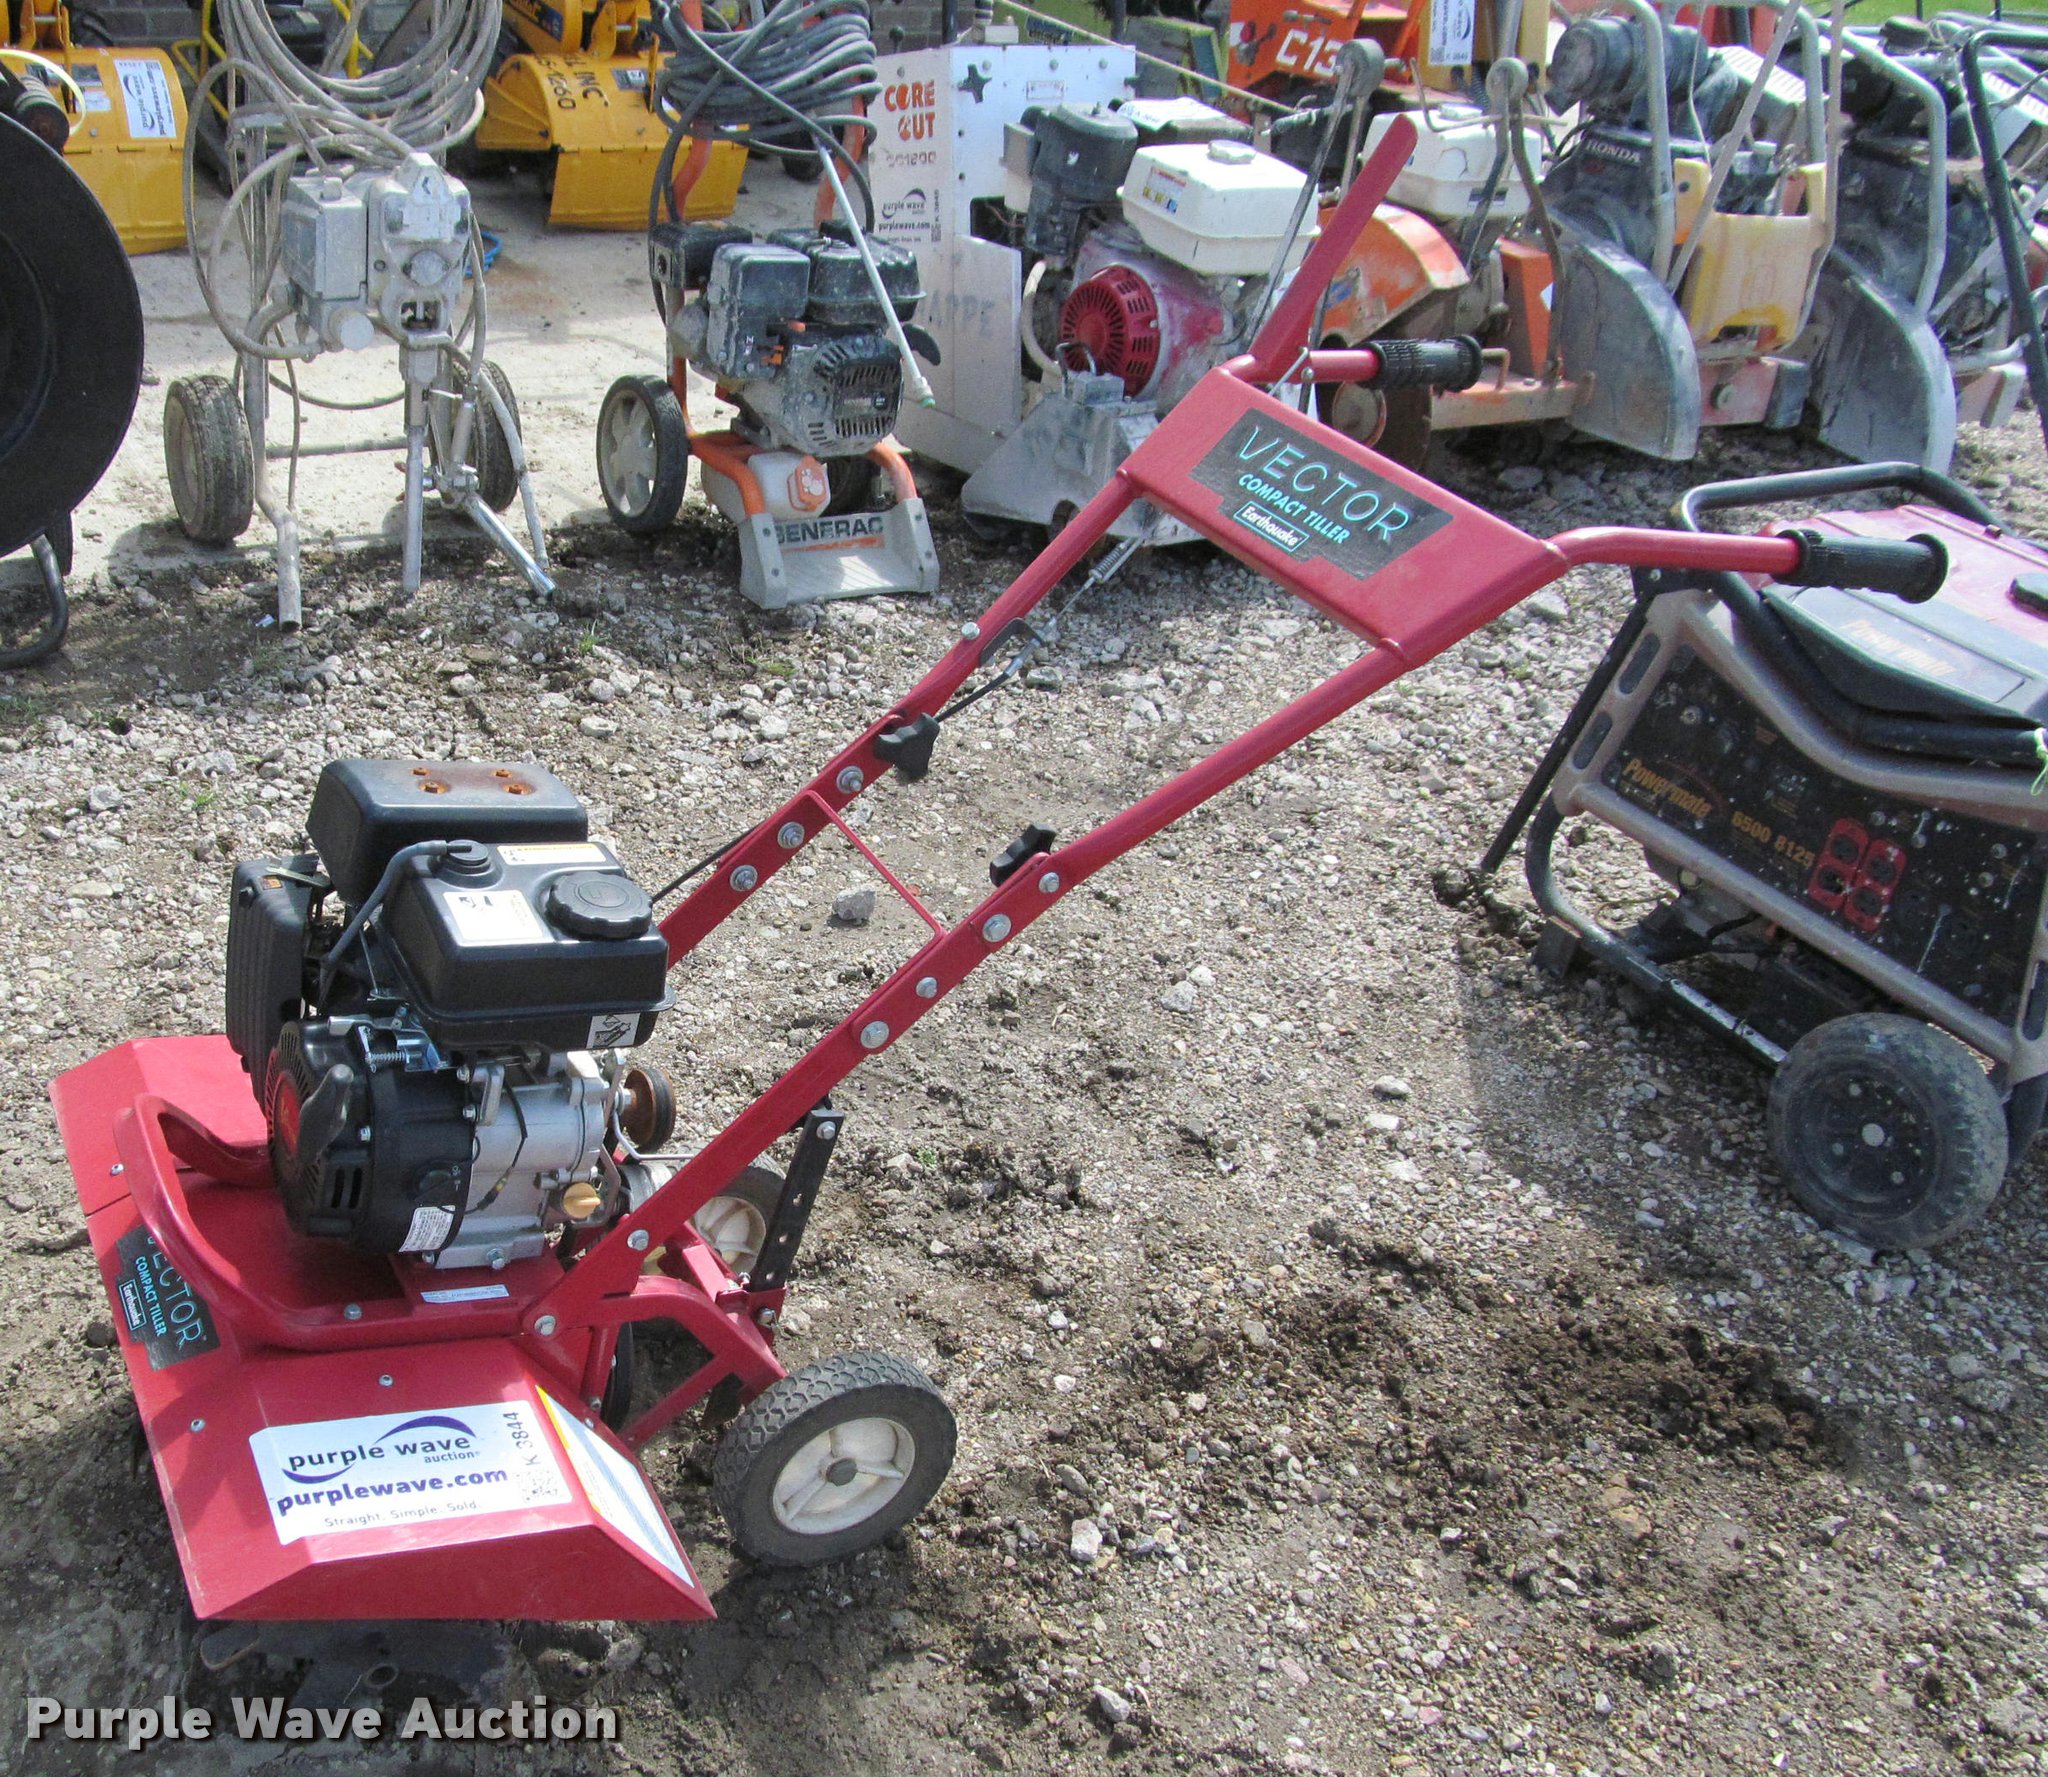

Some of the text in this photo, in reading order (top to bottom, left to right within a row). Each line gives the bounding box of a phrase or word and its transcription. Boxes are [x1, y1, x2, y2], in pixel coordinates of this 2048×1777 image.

[884, 81, 936, 112] CORE
[898, 112, 936, 142] CUT
[1586, 140, 1641, 163] HONDA
[1238, 425, 1411, 542] VECTOR
[1238, 473, 1351, 544] COMPACT TILLER
[1241, 505, 1300, 547] Earthquake
[1622, 758, 1713, 819] Powermate
[1731, 811, 1773, 844] 6500
[123, 1283, 141, 1327] Earthquake
[135, 1256, 167, 1337] COMPACT TILLER
[288, 1436, 471, 1471] purple wave
[423, 1451, 475, 1464] auction
[502, 1410, 541, 1466] K 3844
[276, 1469, 508, 1516] purplewave.com
[324, 1500, 481, 1527] Straight. Simple. Sold.
